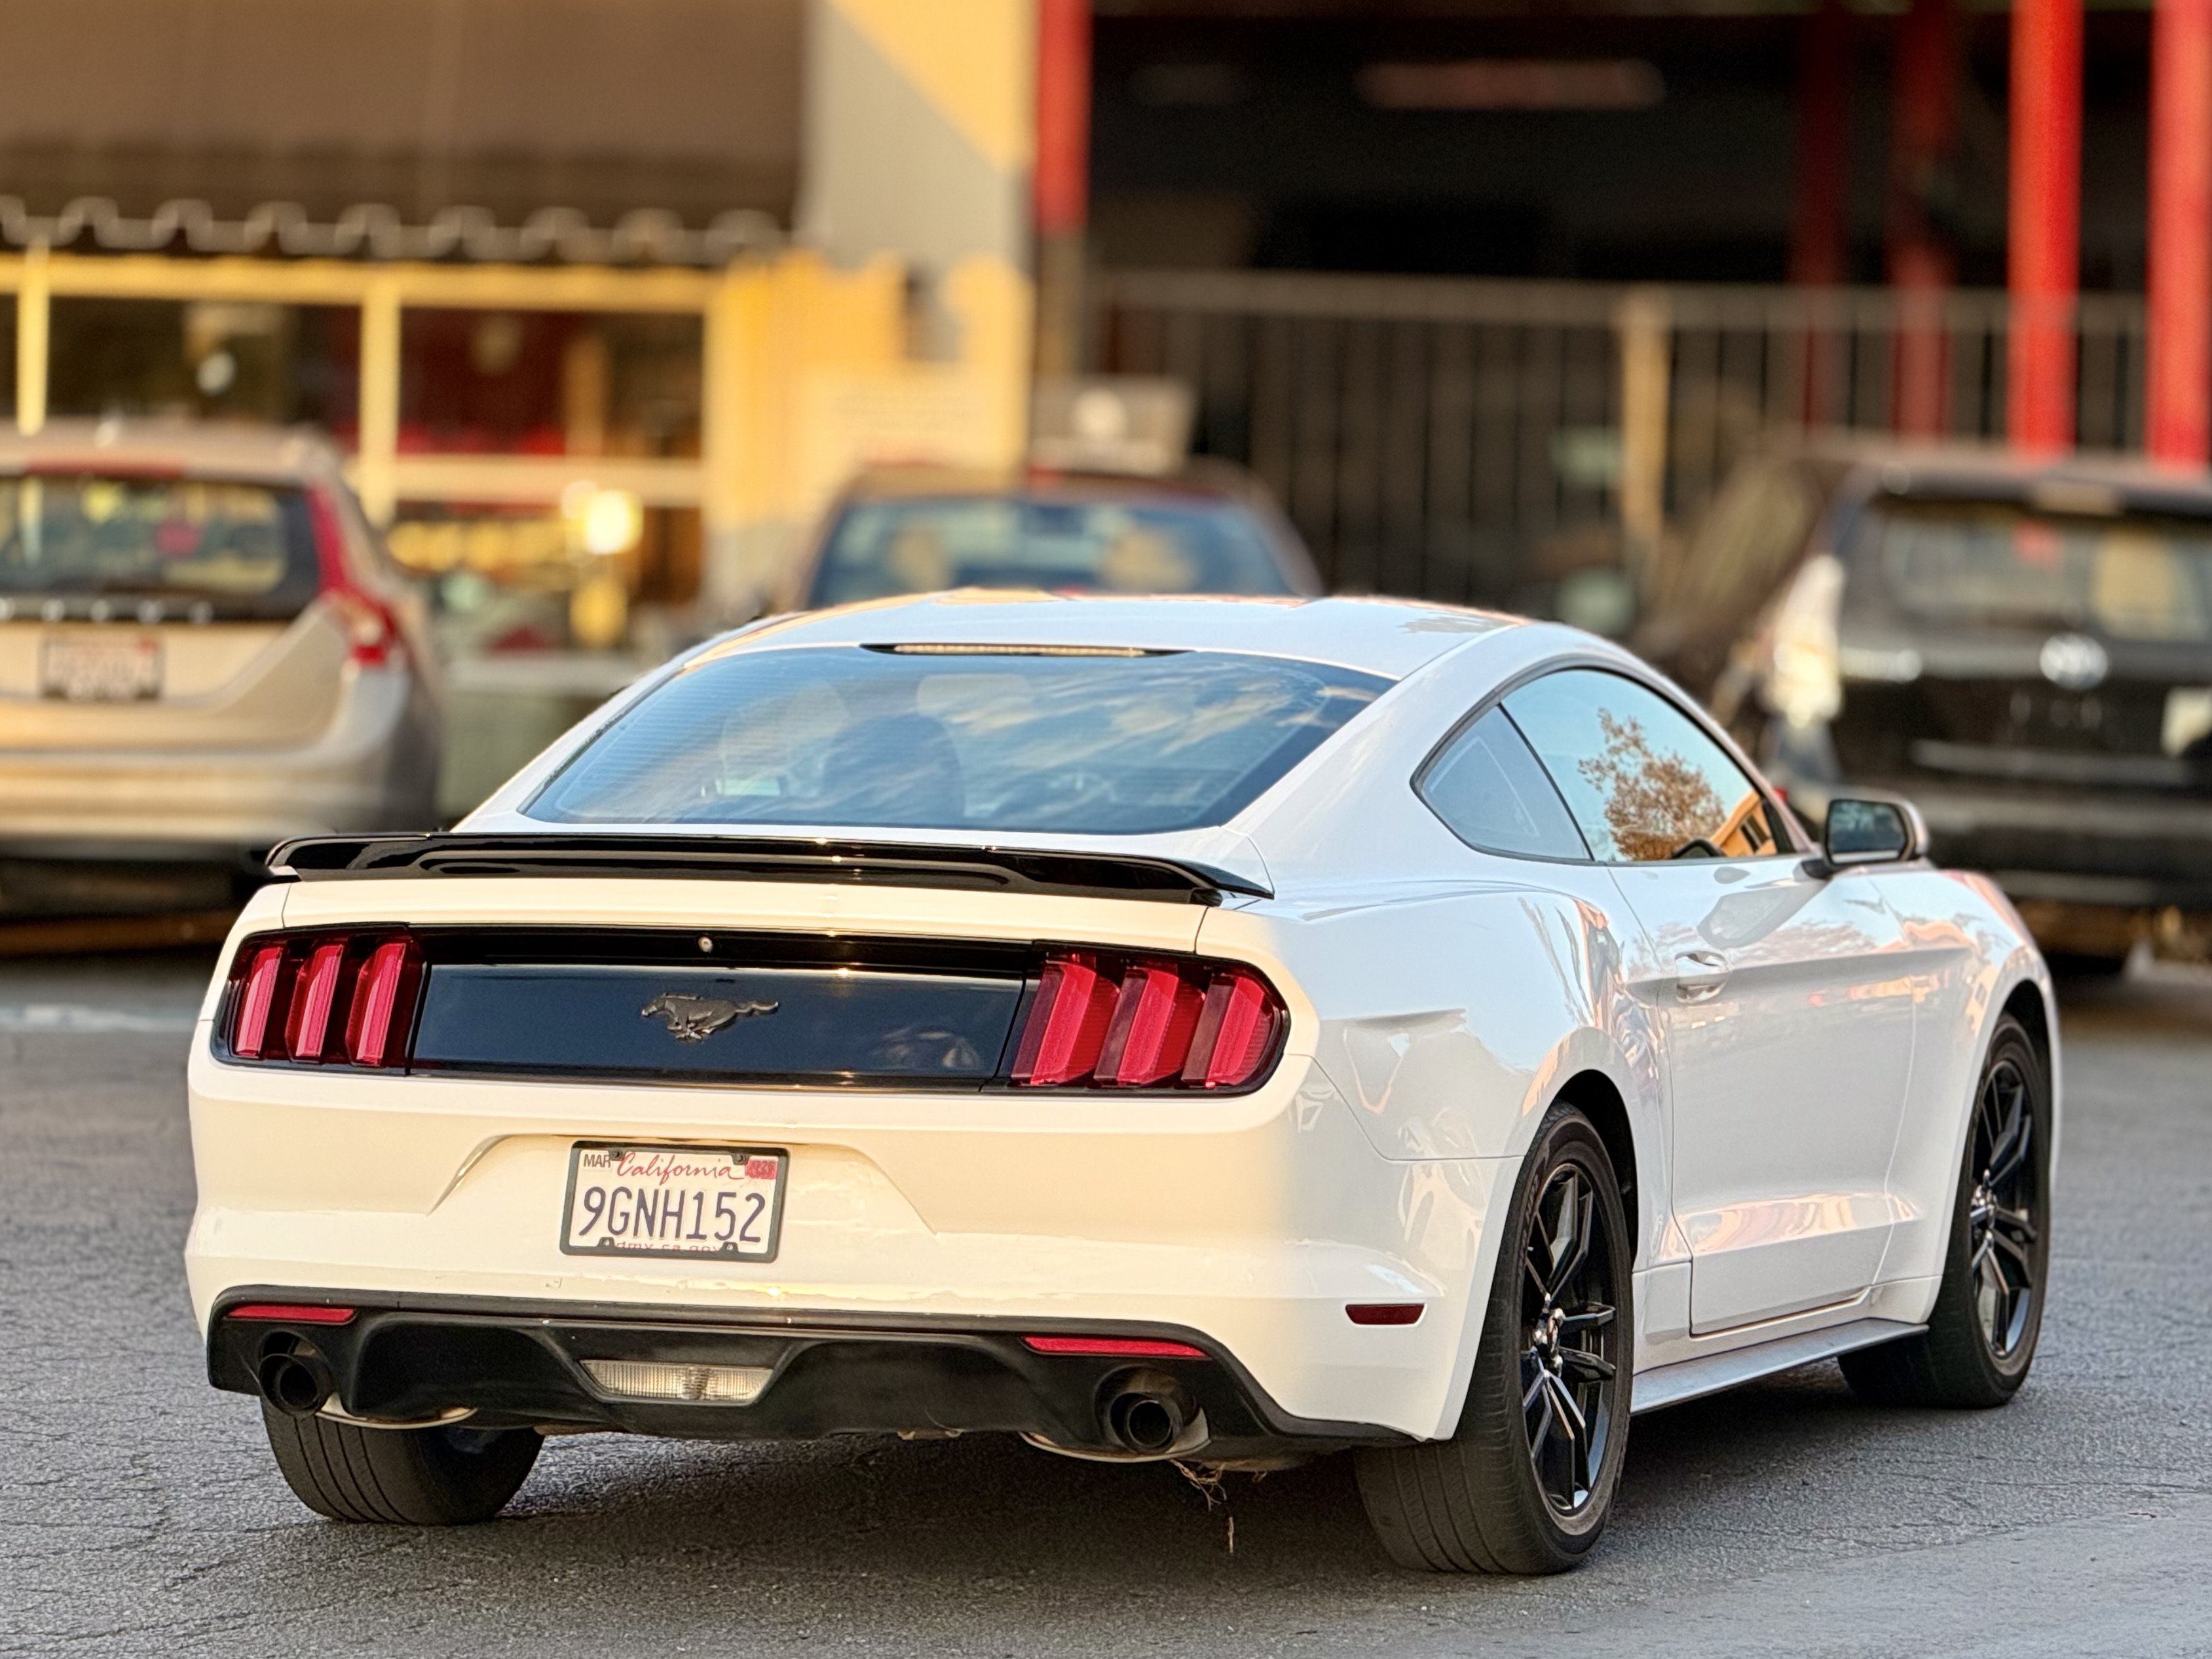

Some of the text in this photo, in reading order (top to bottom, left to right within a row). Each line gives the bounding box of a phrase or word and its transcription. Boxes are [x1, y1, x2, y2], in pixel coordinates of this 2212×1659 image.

[584, 1154, 611, 1168] MAR
[617, 1151, 745, 1185] California
[579, 1186, 766, 1243] 9GNH152
